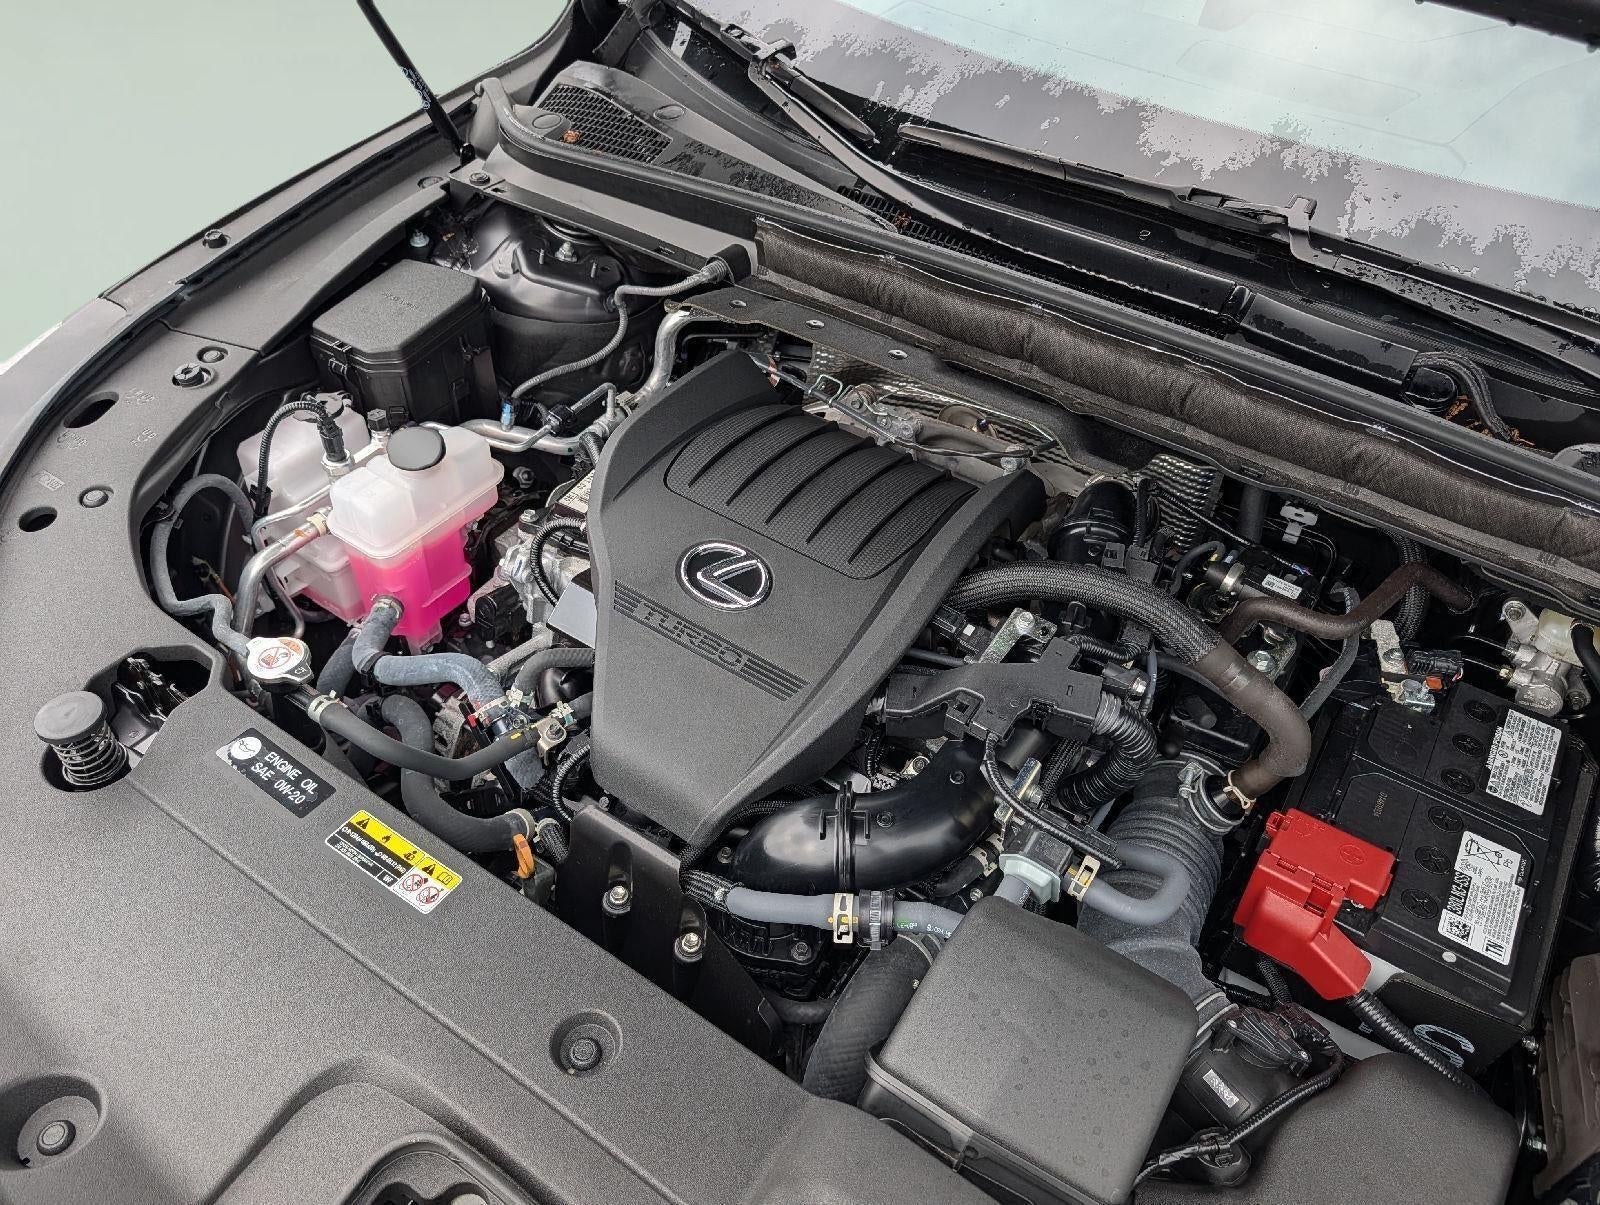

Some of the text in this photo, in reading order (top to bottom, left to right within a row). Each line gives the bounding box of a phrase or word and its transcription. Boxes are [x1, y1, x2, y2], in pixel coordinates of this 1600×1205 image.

[644, 602, 744, 668] TURBO
[250, 761, 306, 806] SAE 0W-20
[264, 751, 319, 795] ENGINE OIL
[1484, 939, 1505, 957] TN
